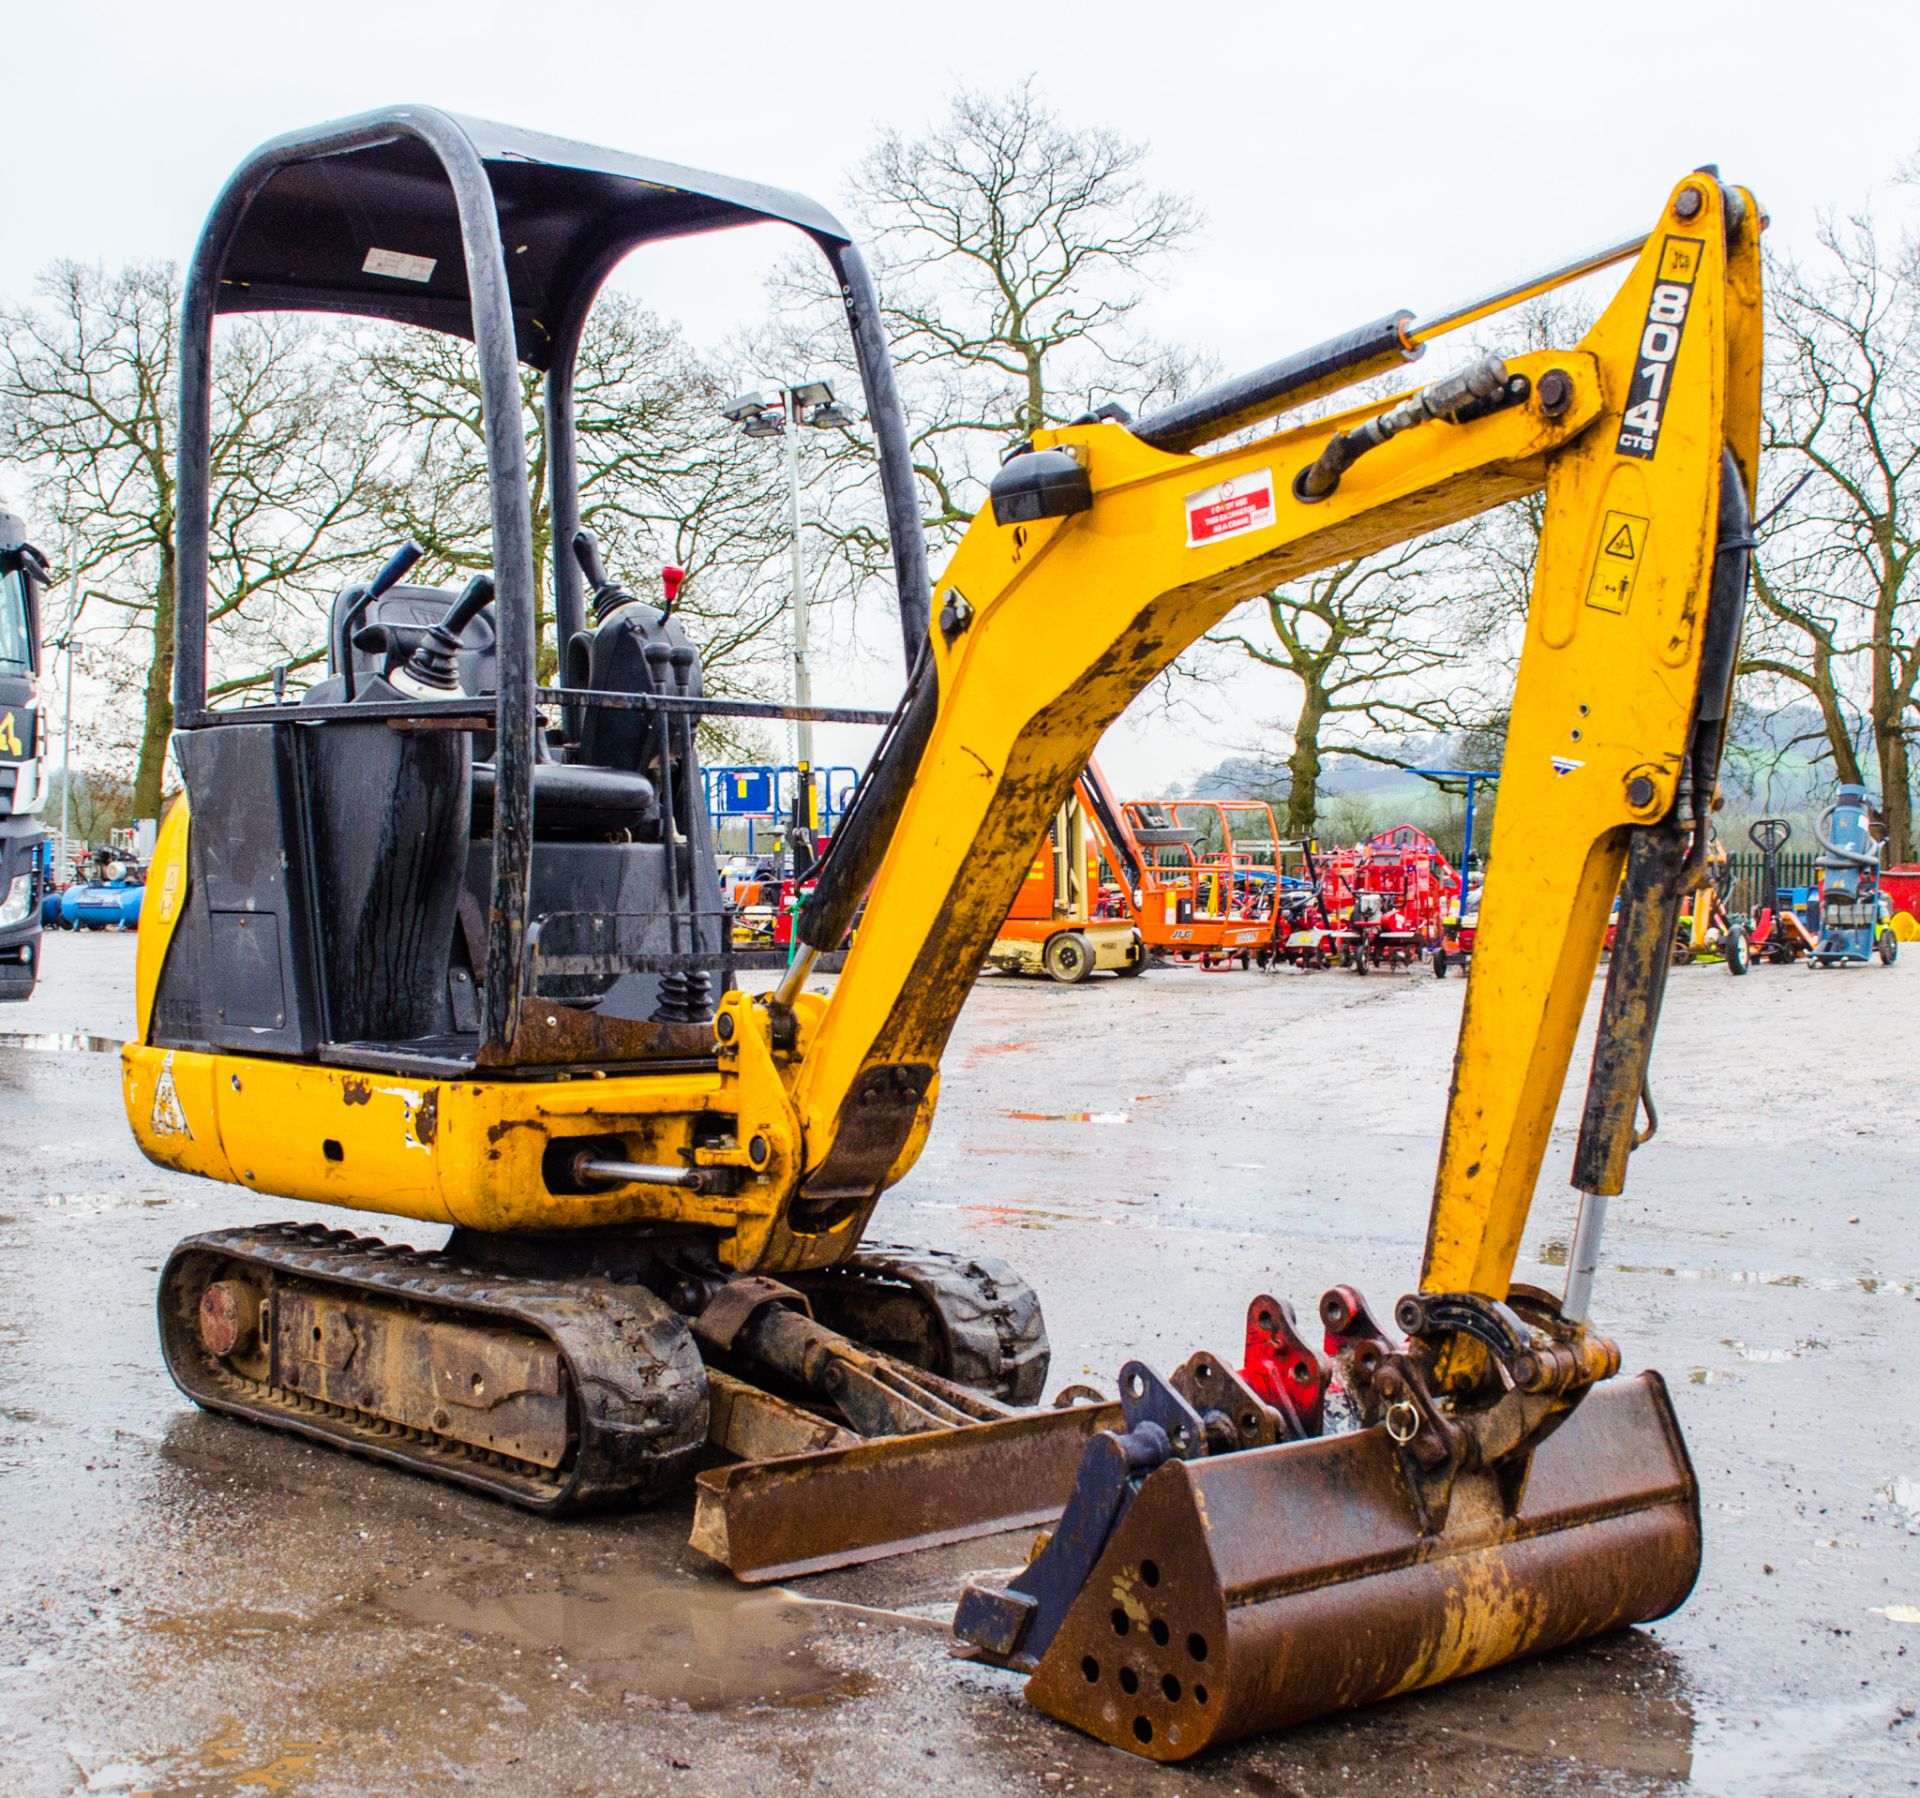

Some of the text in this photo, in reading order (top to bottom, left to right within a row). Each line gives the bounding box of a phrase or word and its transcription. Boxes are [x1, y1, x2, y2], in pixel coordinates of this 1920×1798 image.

[1623, 284, 1689, 437] 8014
[1619, 433, 1653, 451] CTS
[1171, 929, 1193, 939] JLG
